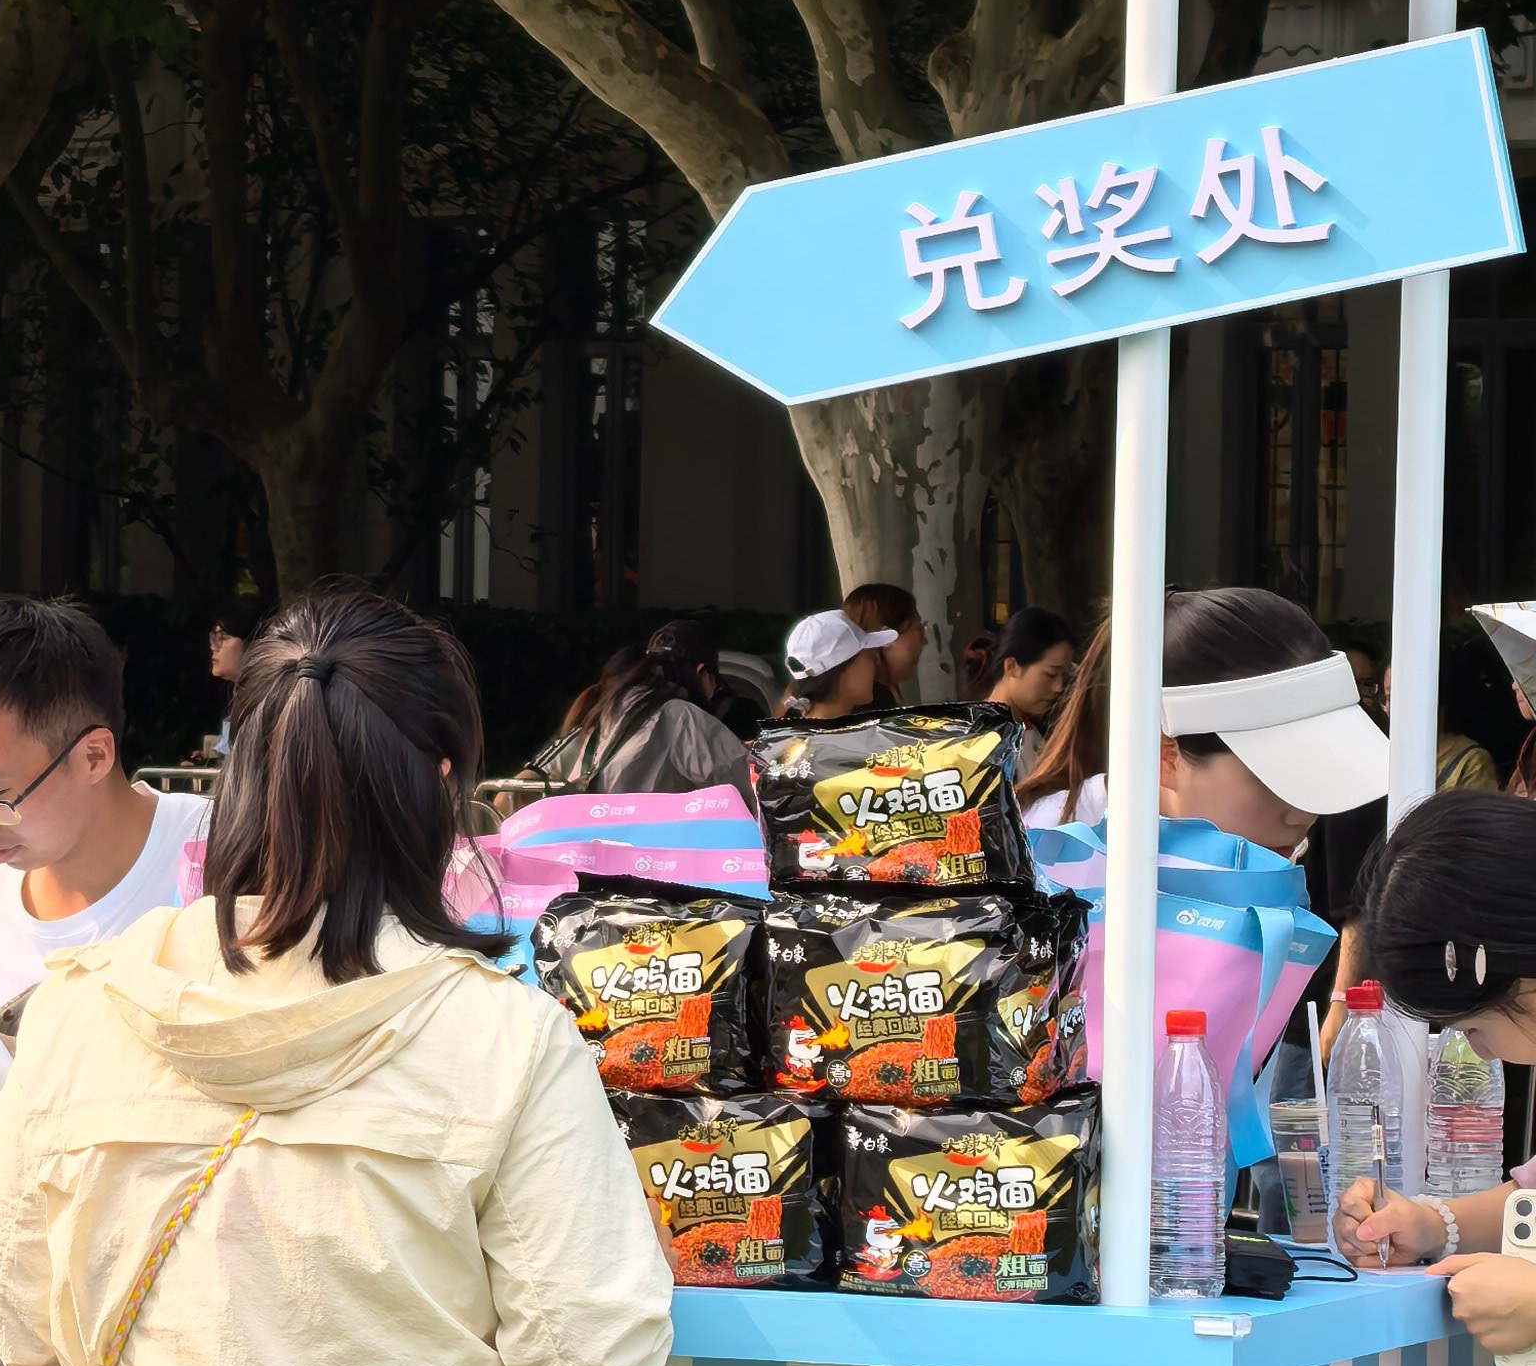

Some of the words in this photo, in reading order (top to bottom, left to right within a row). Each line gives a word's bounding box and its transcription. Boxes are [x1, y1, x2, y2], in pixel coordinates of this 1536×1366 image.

[896, 125, 1336, 330] 兑奖处
[839, 769, 965, 827] 火鸡面
[873, 816, 944, 842] 经典口味
[591, 951, 703, 1002] 火鸡面
[615, 997, 676, 1020] 经典口味
[827, 971, 944, 1021] 火鸡面
[856, 1015, 921, 1038] 经典口味
[662, 1036, 709, 1062] 粗面
[910, 1056, 957, 1083] 粗面
[650, 1153, 771, 1200] 火鸡面
[911, 1167, 1036, 1212] 火鸡面
[679, 1197, 745, 1219] 经典口味
[940, 1211, 1009, 1231] 经典口味
[733, 1236, 782, 1263] 粗面
[995, 1251, 1045, 1277] 粗面
